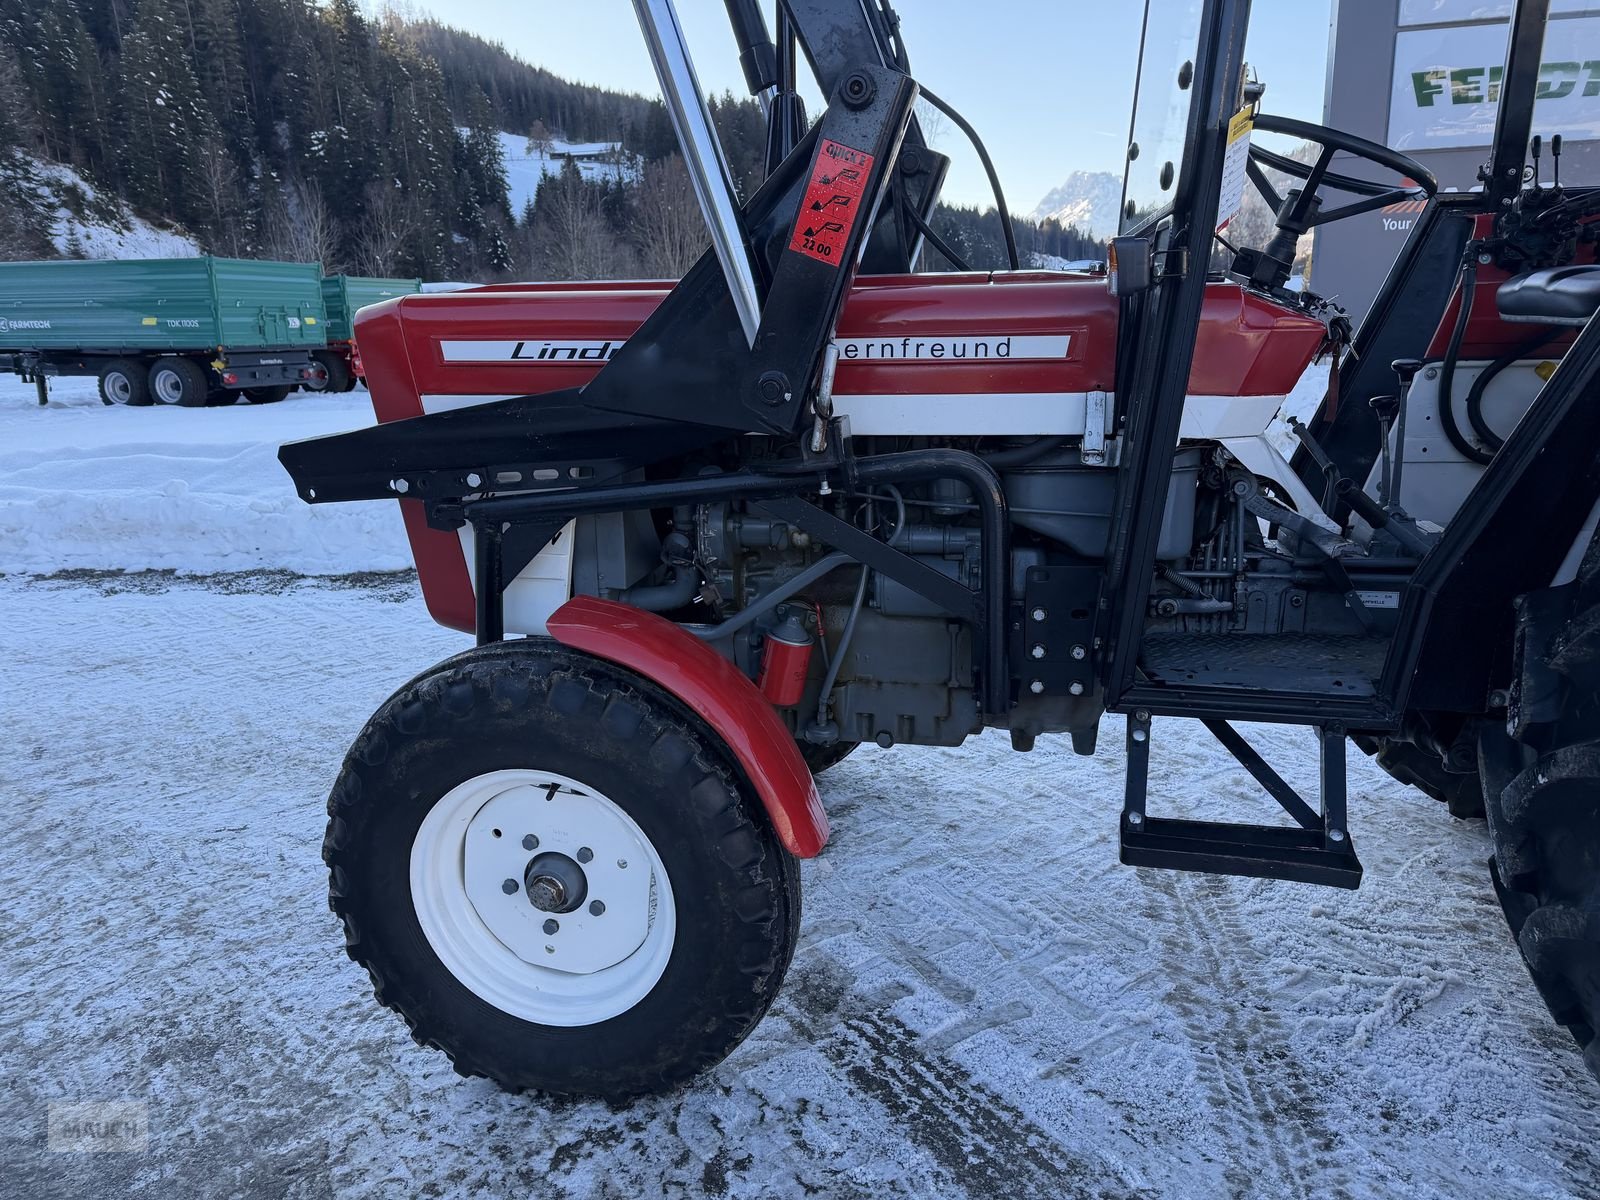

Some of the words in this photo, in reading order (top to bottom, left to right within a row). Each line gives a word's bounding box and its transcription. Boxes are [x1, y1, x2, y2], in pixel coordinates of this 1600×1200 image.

[1411, 60, 1600, 107] FED
[1382, 218, 1412, 231] Your
[9, 320, 51, 329] FARMTECH
[838, 337, 1012, 359] ernfreund
